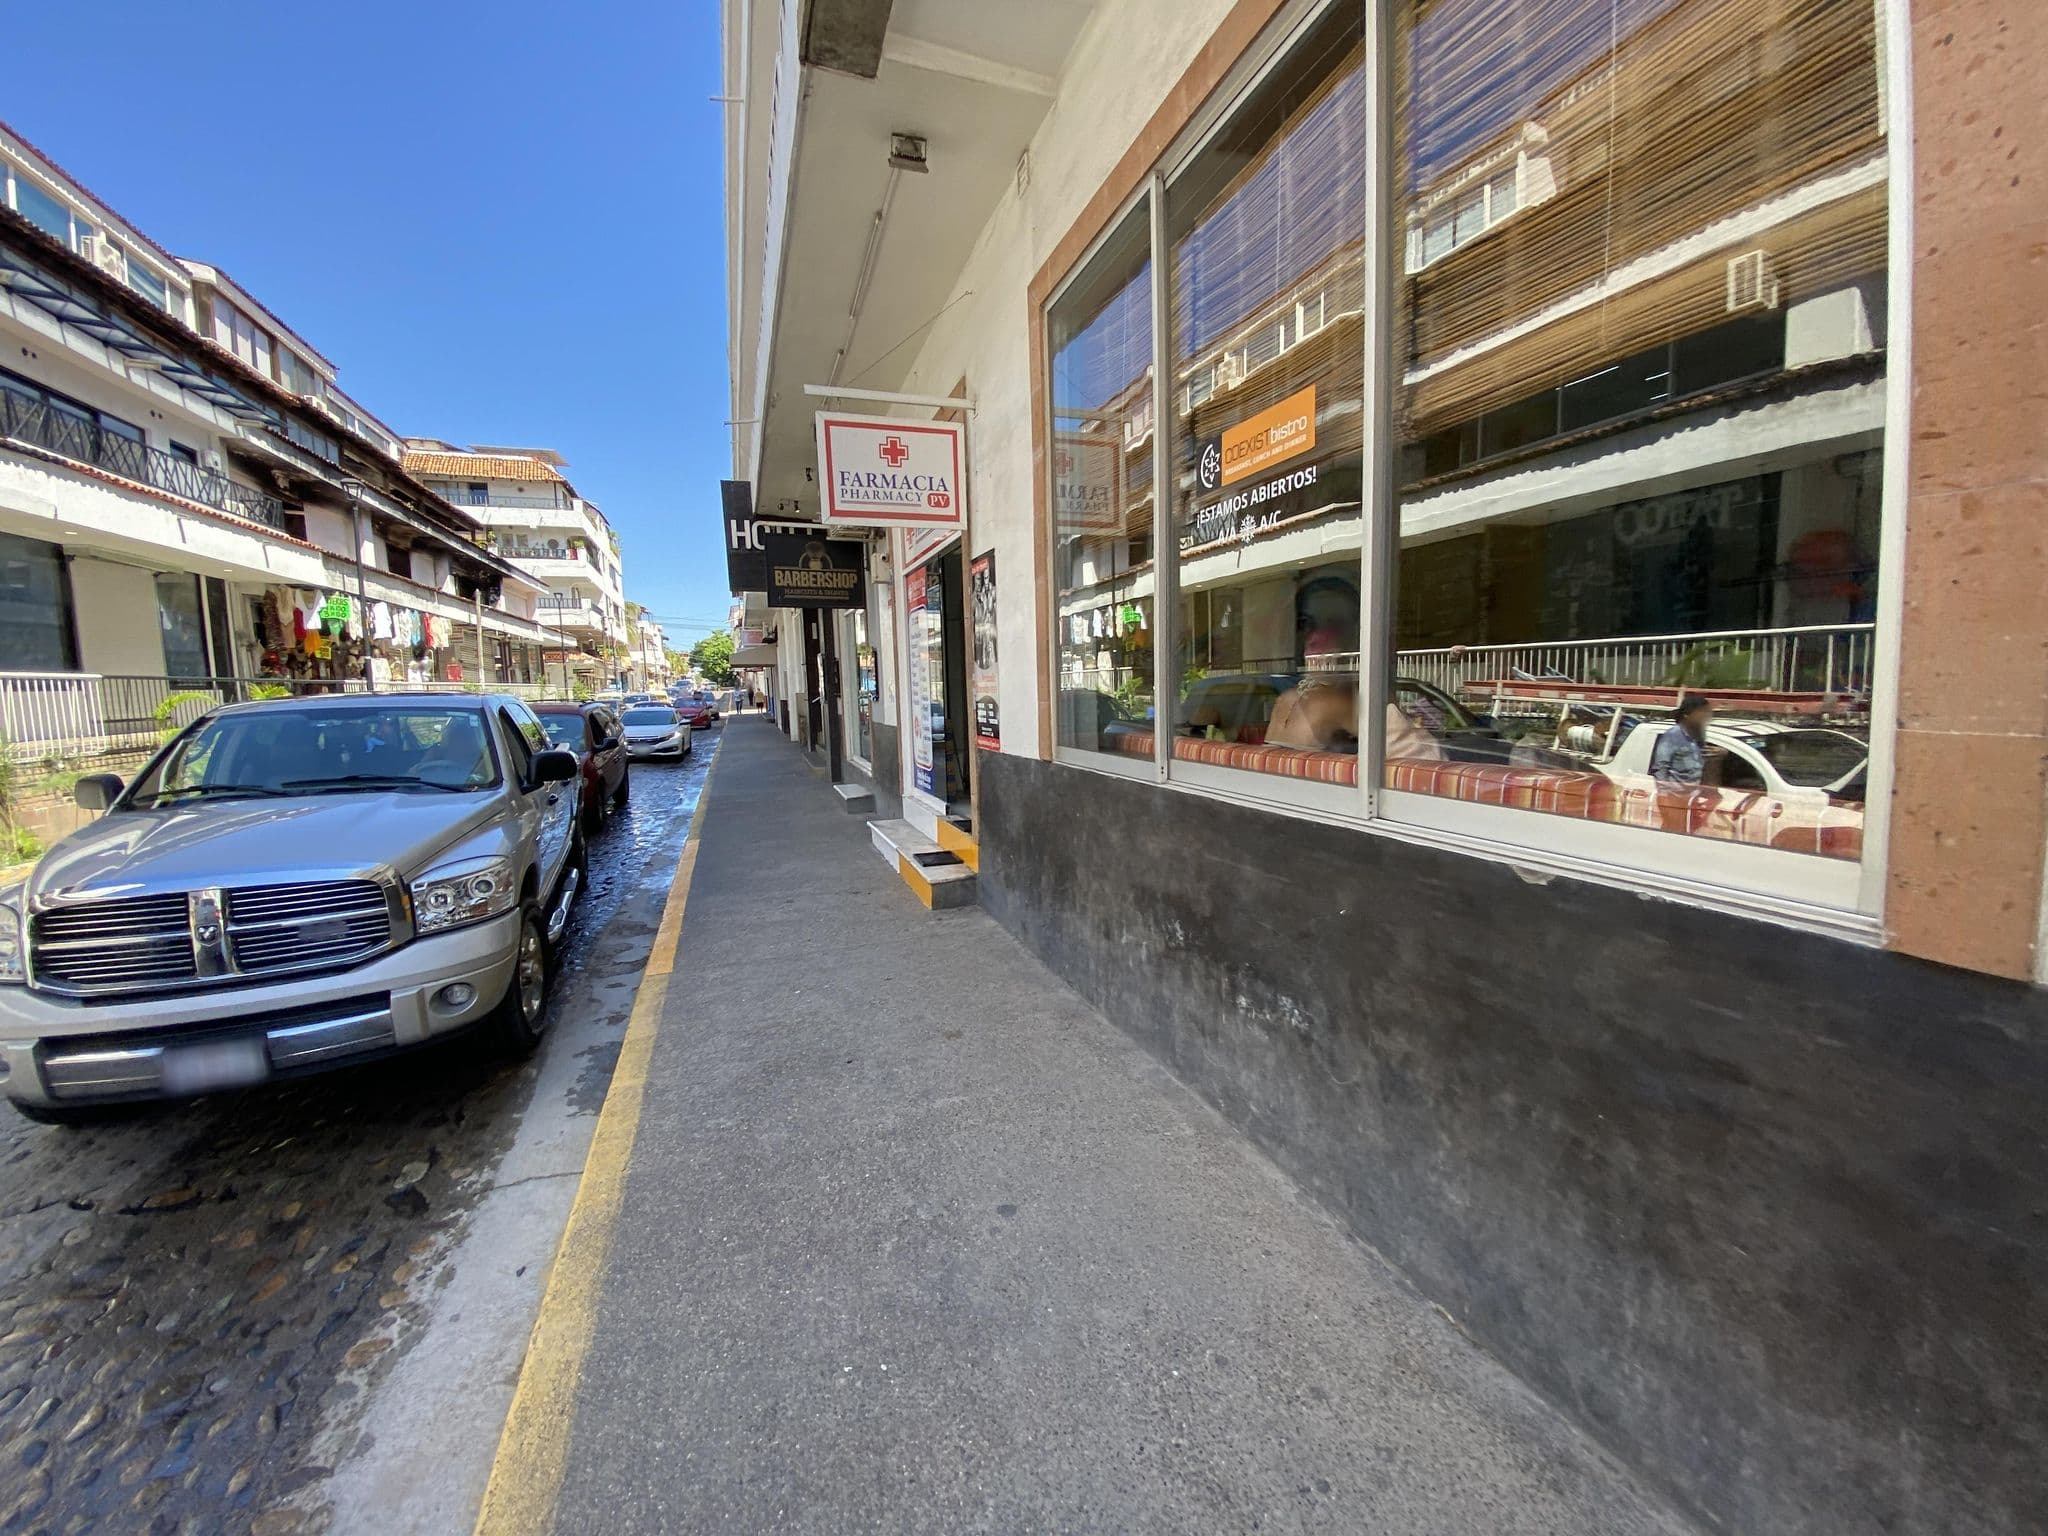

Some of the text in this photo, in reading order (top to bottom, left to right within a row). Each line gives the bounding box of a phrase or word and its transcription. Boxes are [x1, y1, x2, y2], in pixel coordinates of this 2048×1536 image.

[840, 470, 949, 492] FARMACIA
[840, 488, 947, 508] PHARMACY PV
[1196, 466, 1317, 528] ¡ESTAMOS ABIERTOS!
[1260, 510, 1281, 529] A/C
[774, 569, 858, 589] BARBERSHOP
